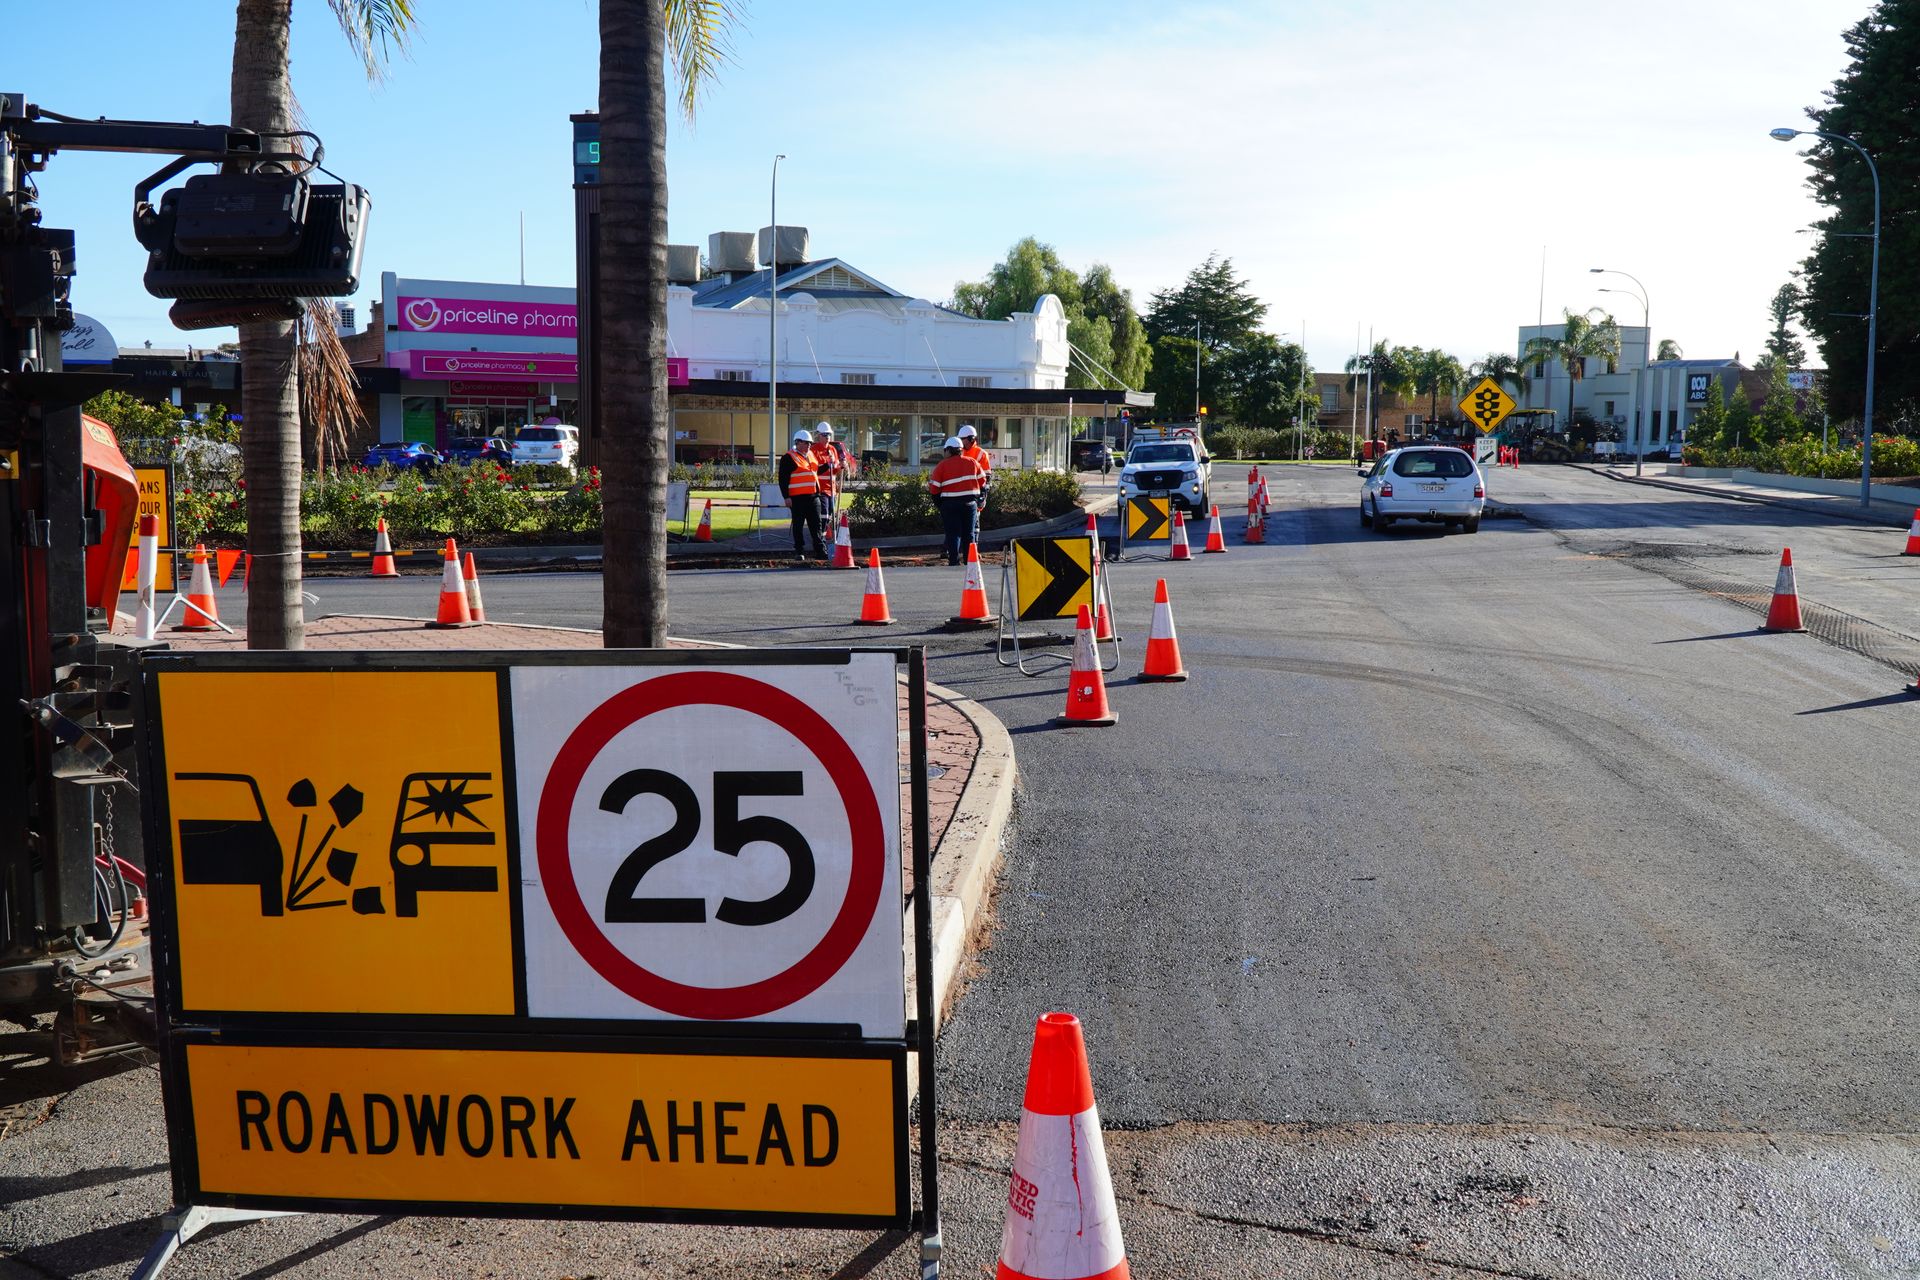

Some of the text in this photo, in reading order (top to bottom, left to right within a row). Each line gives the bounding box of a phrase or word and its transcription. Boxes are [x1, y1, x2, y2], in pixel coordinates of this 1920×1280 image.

[443, 307, 518, 325] priceline
[491, 362, 526, 371] pharmacy
[171, 369, 178, 377] &
[182, 370, 219, 378] BEAUTY
[1691, 392, 1706, 400] ABC
[599, 768, 816, 926] 25
[236, 1090, 840, 1168] ROADWORK AHEAD
